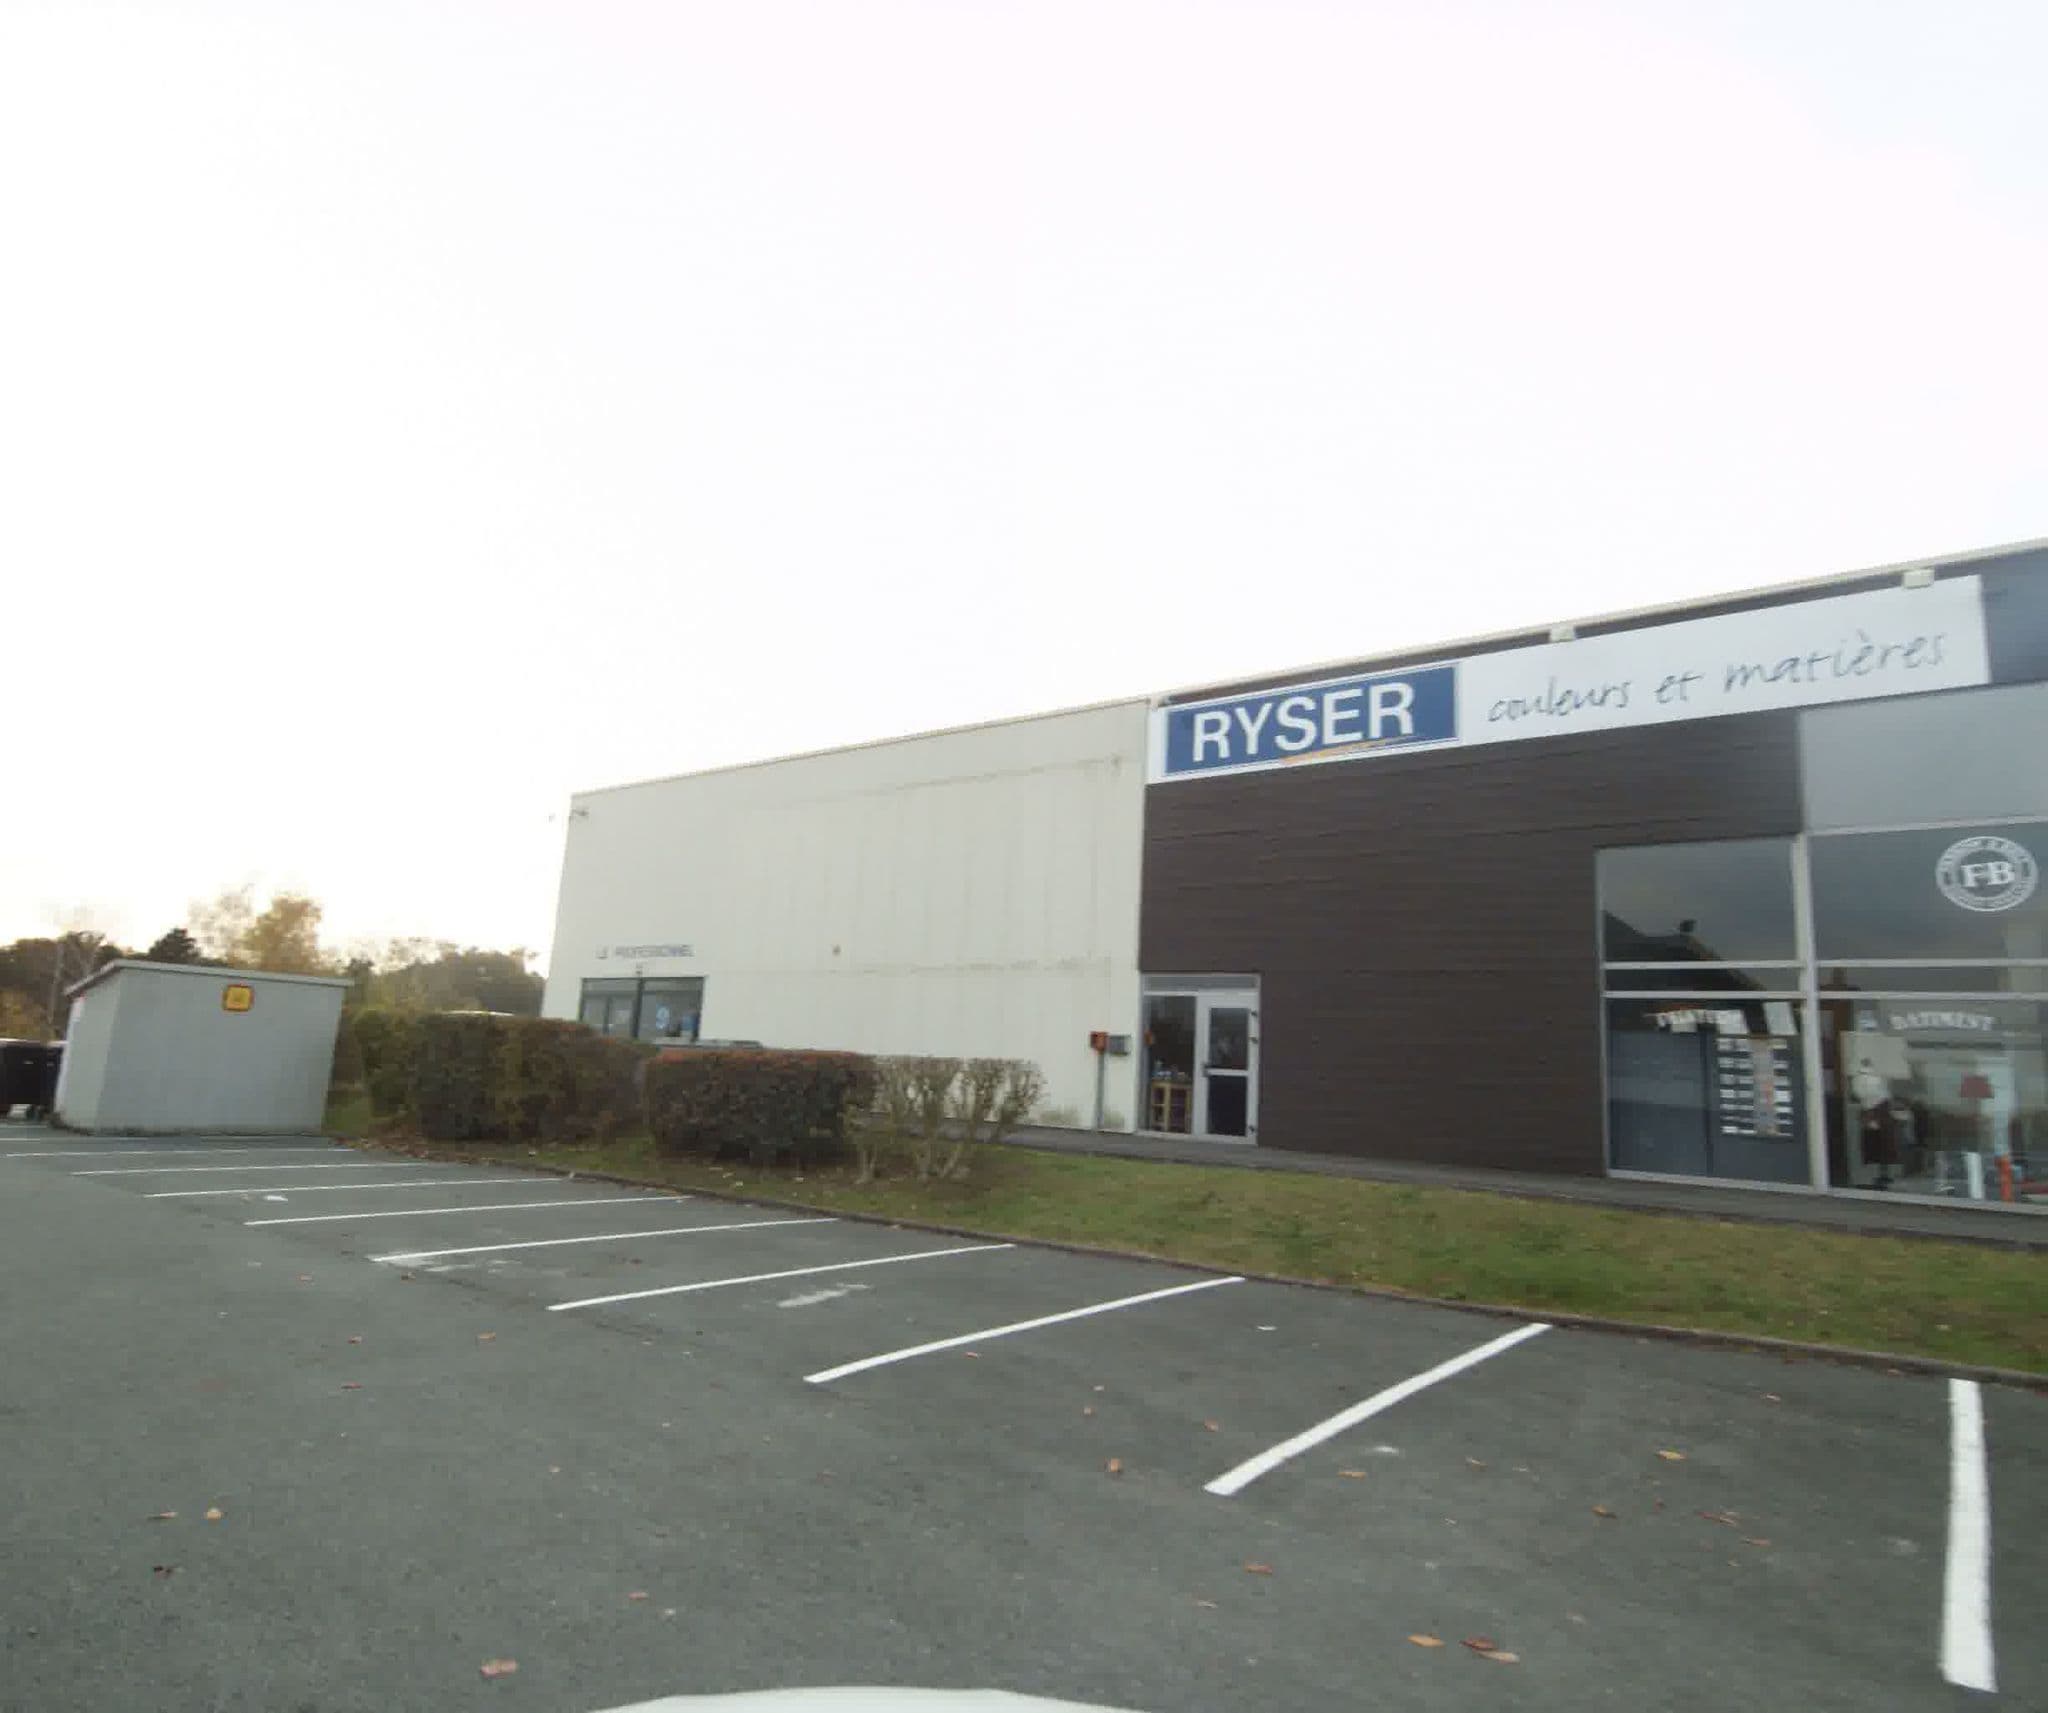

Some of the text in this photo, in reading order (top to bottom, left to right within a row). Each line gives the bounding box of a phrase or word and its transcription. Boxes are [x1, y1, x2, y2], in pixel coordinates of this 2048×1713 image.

[1488, 629, 1946, 723] couleurs et matières
[1192, 682, 1415, 763] RYSER
[1960, 861, 2016, 887] FB
